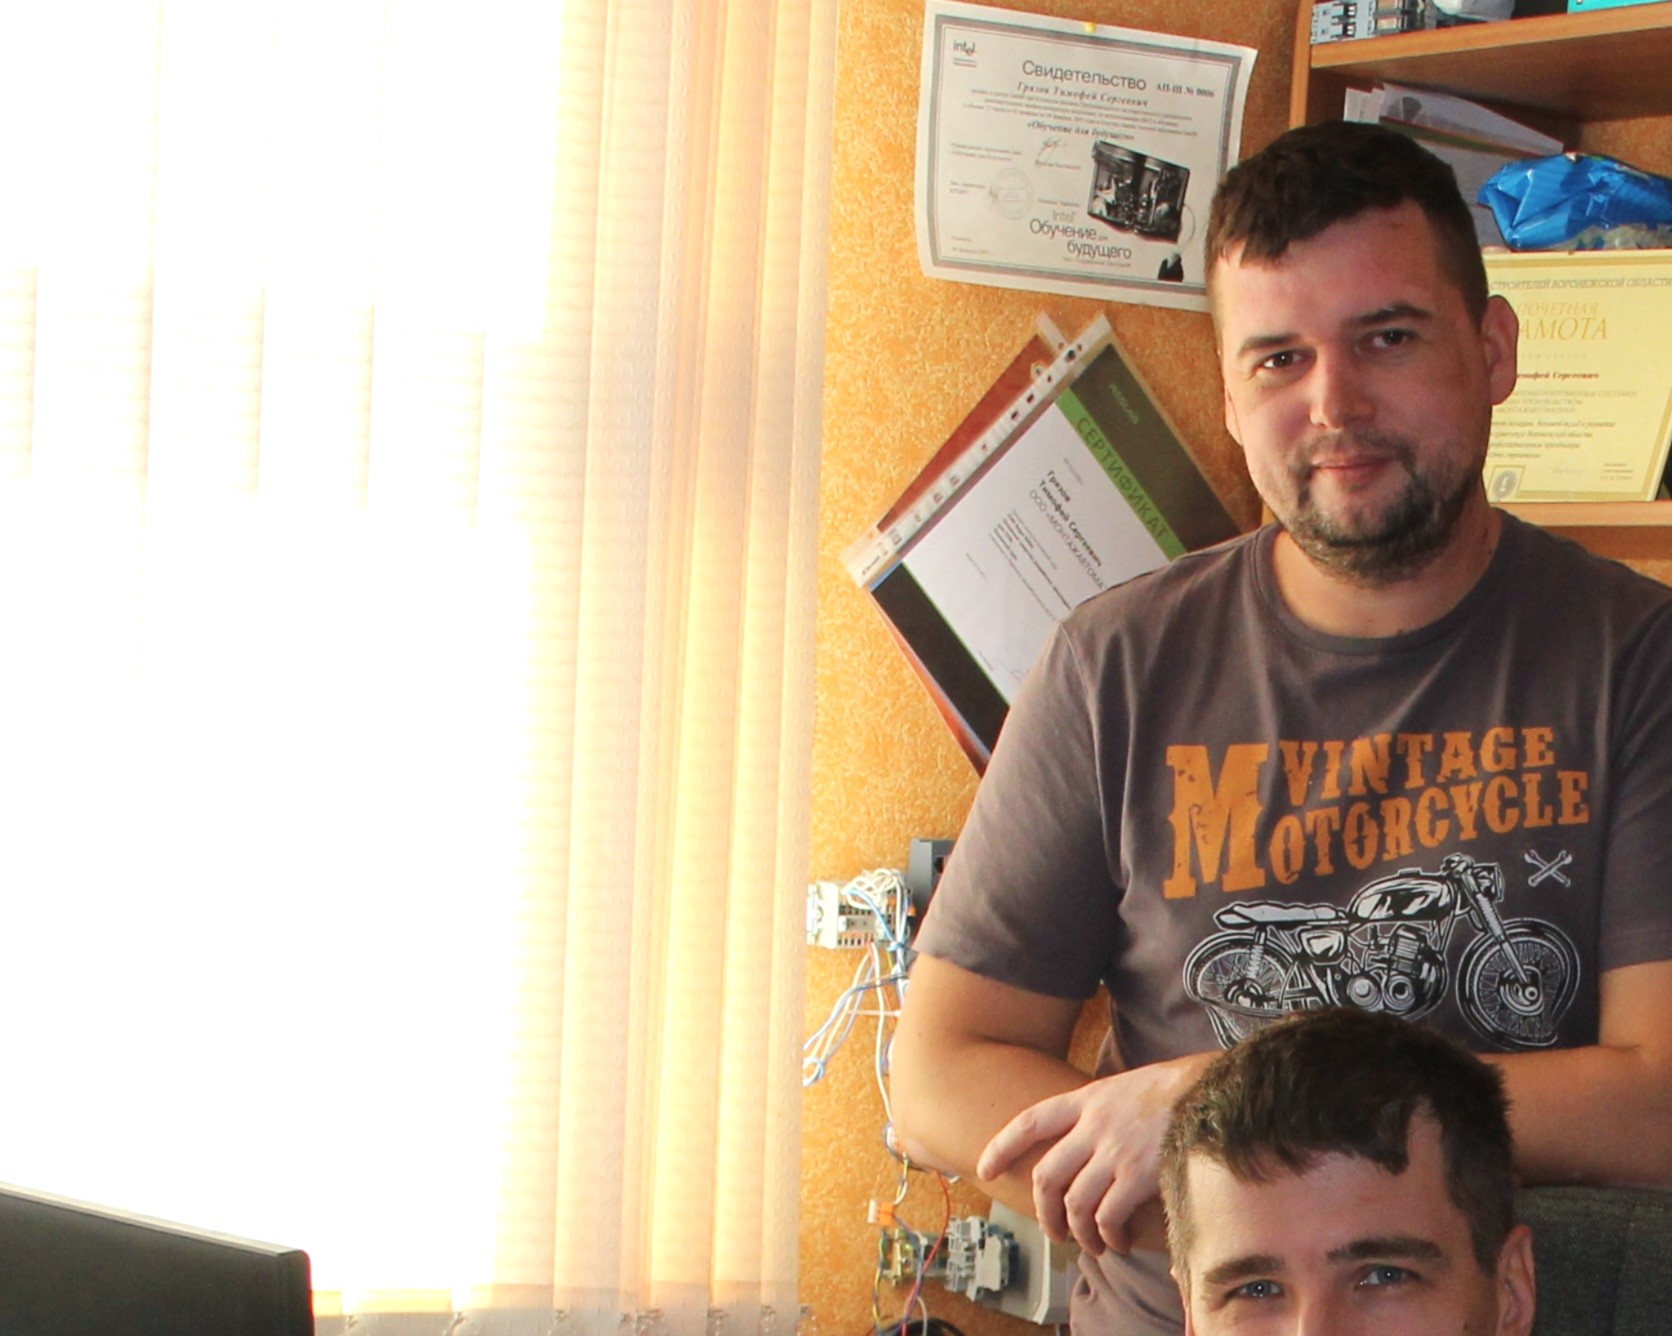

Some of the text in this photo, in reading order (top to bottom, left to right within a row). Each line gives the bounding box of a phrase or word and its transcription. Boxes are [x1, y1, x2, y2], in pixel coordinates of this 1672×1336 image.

[1022, 59, 1147, 91] Свидетельство
[1017, 80, 1149, 108] Грязов Тимофей Сергеевич
[1030, 218, 1097, 240] Обучение
[1067, 239, 1132, 260] будущего
[1517, 316, 1608, 341] АМОТА
[1047, 469, 1072, 503] Грязов
[1076, 417, 1168, 539] СЕРТИФИКАТ
[1029, 490, 1047, 513] ООО
[1046, 511, 1105, 590] «МОНТАЖАВТОМА
[1039, 480, 1070, 522] Тимофей
[1068, 521, 1103, 567] Сергеевич
[1279, 726, 1555, 806] VINTAGE
[1163, 743, 1590, 900] MOTORCYCLE
